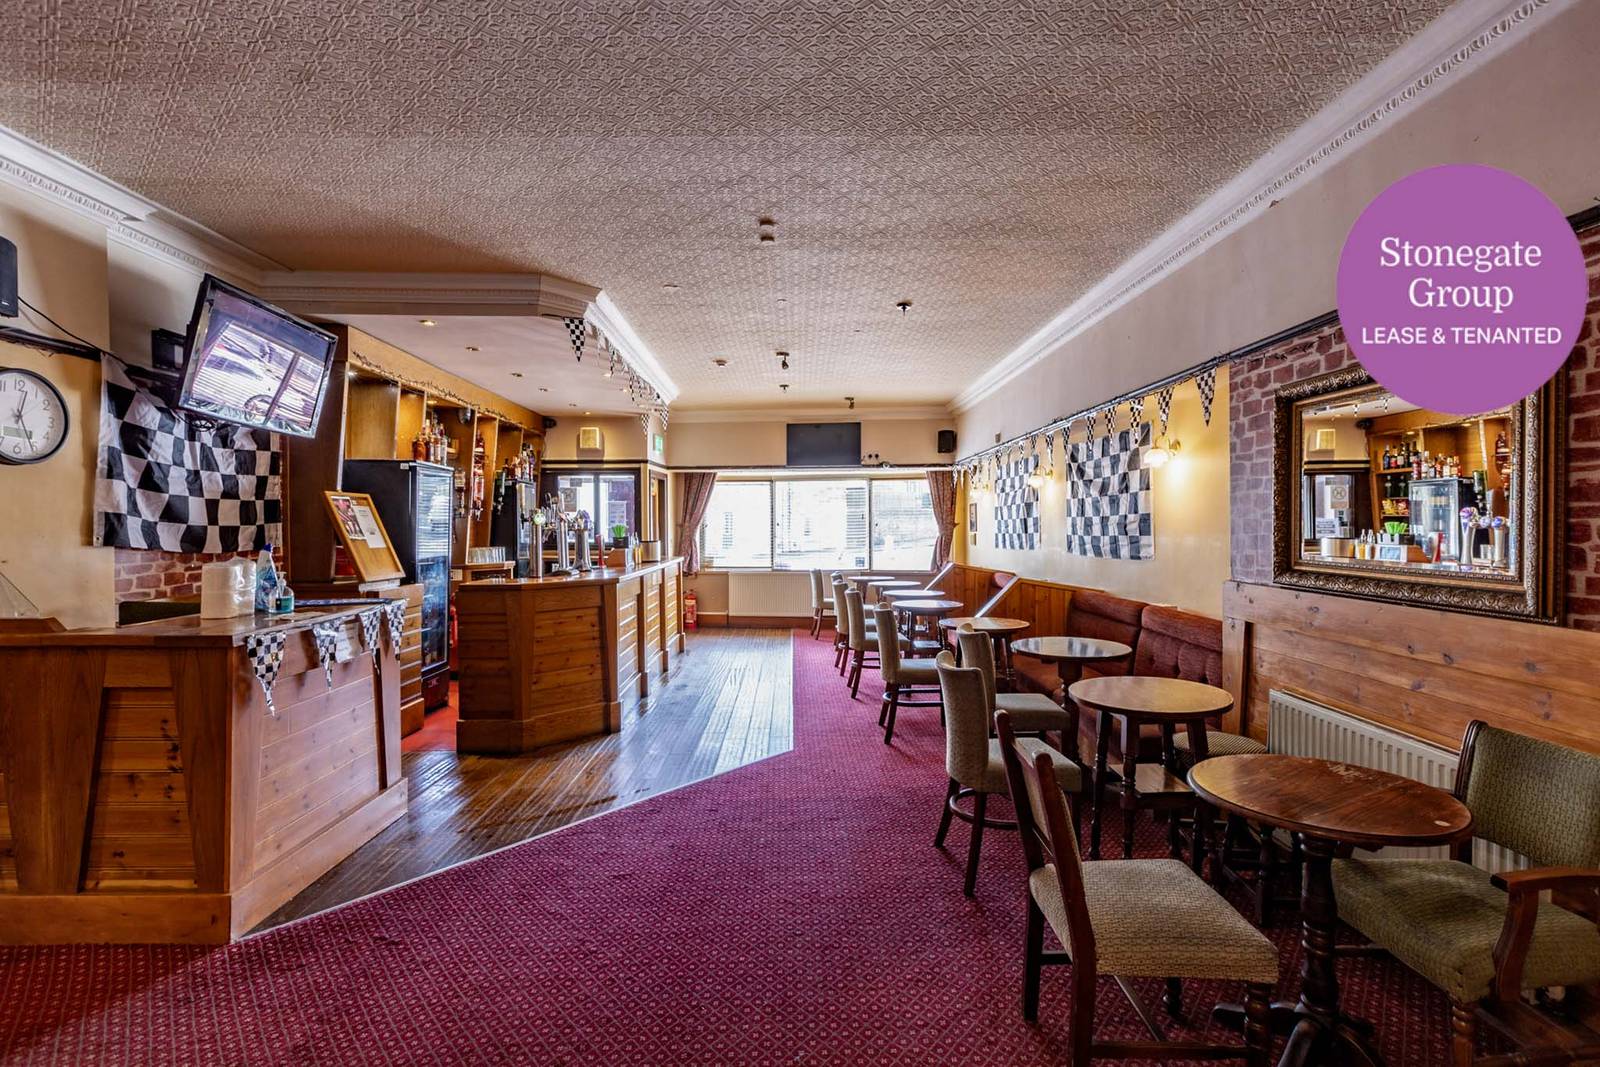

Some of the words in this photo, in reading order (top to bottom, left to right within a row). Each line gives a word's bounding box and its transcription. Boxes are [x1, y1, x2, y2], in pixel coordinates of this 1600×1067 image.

[14, 378, 26, 393] 12
[43, 399, 50, 411] 2
[48, 417, 55, 429] 3
[43, 431, 49, 440] 4
[13, 443, 22, 455] 6
